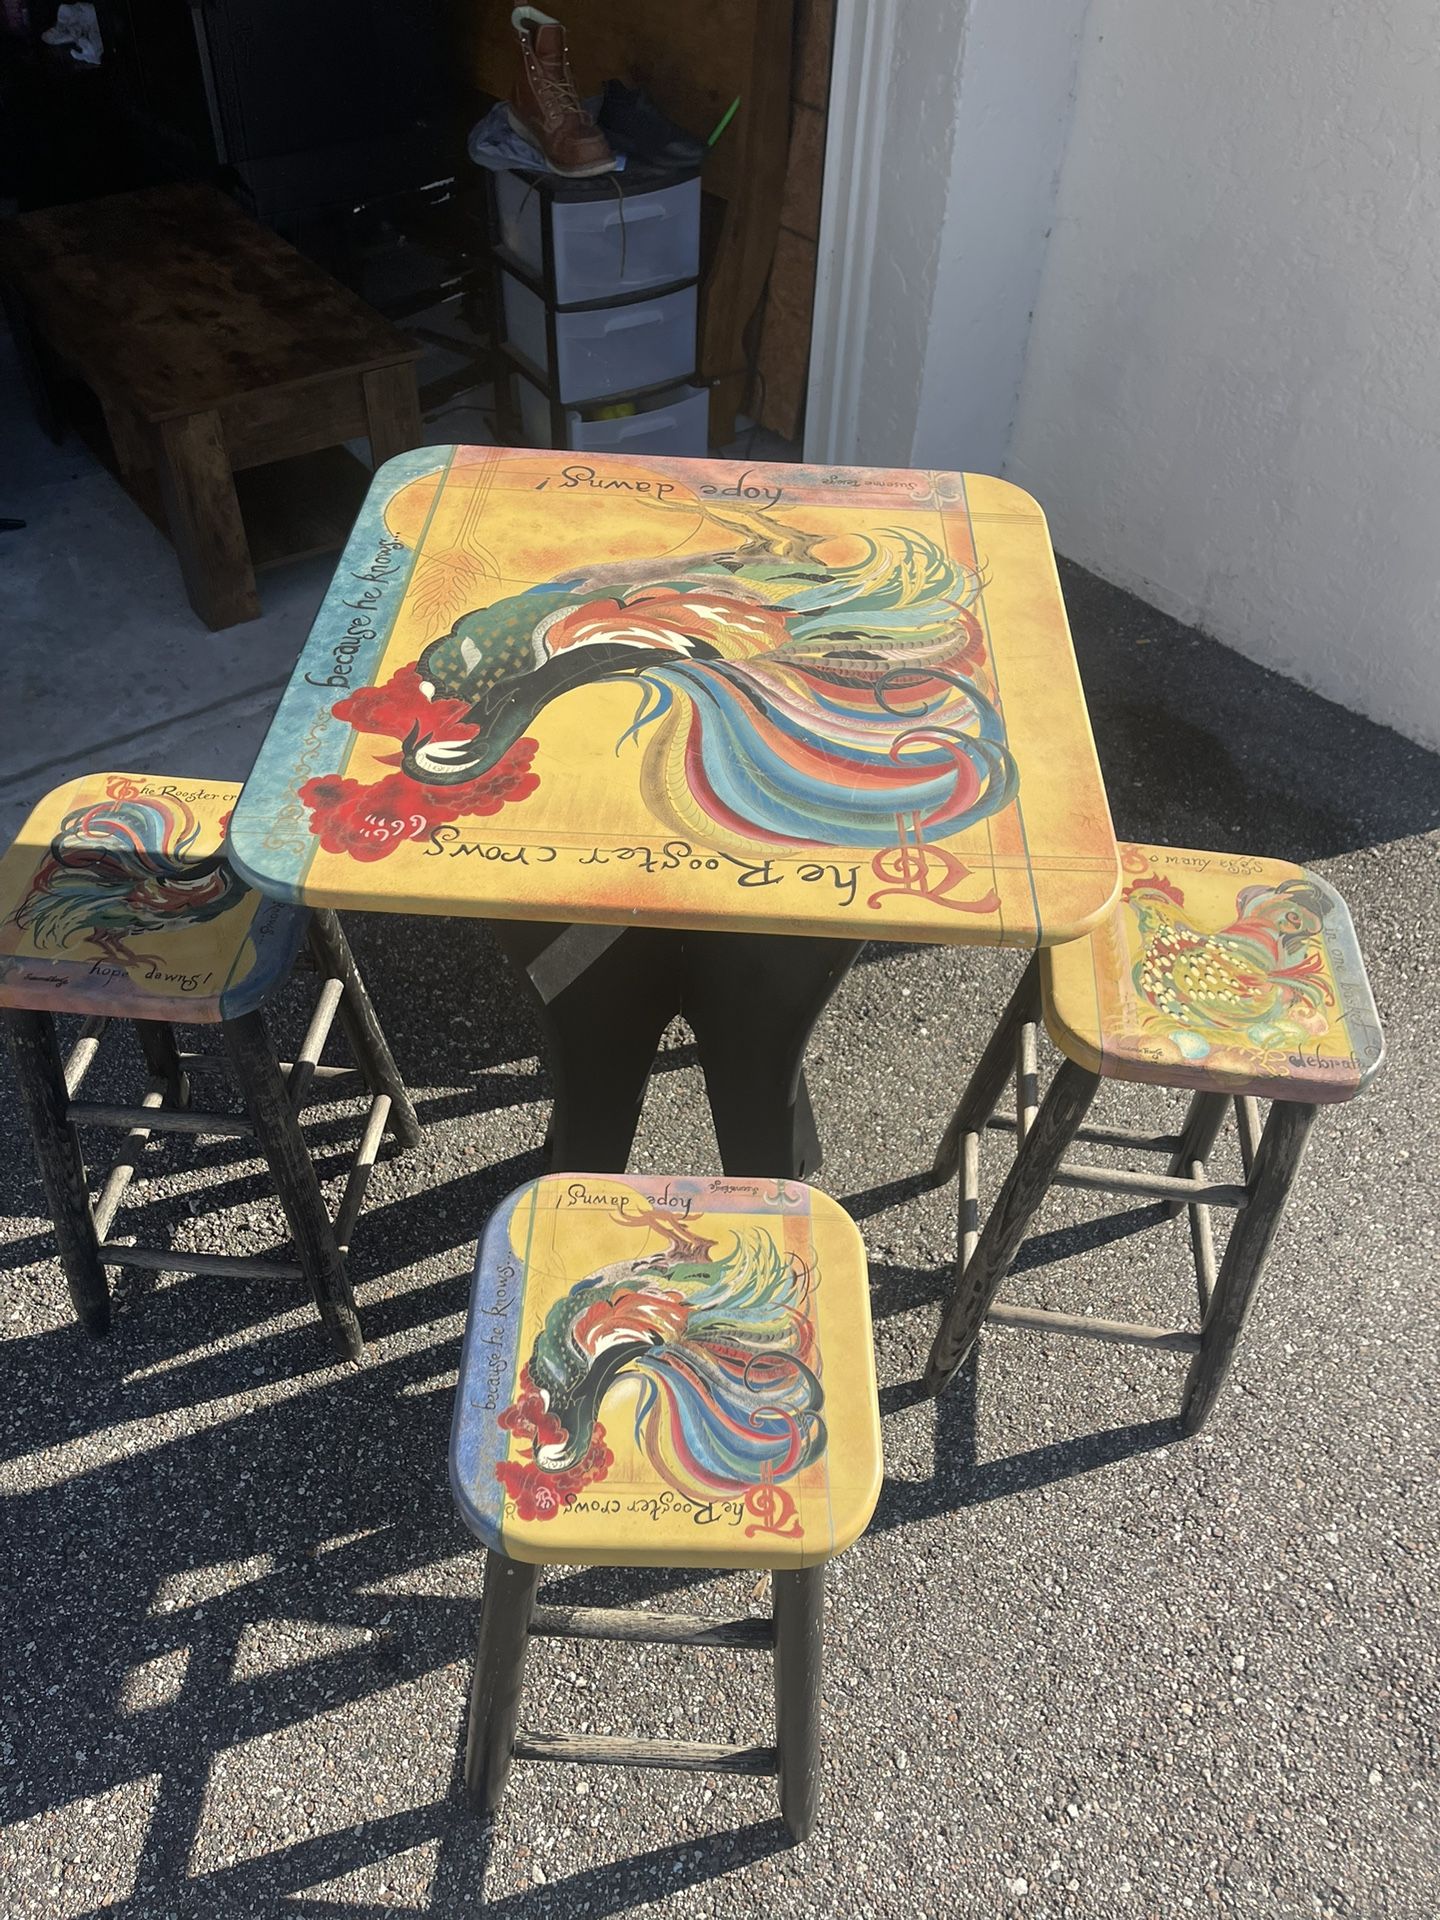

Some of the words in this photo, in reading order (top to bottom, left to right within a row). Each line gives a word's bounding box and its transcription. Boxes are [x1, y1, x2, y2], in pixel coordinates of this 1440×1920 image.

[700, 469, 784, 512] hope
[304, 615, 377, 689] because
[342, 587, 383, 610] he
[105, 775, 155, 812] The
[158, 785, 220, 803] Rooster
[423, 825, 557, 866] crows
[578, 840, 784, 887] Rooster
[797, 811, 1001, 913] The
[1165, 855, 1212, 873] many
[1220, 856, 1263, 875] eggs
[89, 958, 129, 988] hope
[1334, 949, 1347, 973] one
[646, 1182, 692, 1219] hope
[480, 1326, 505, 1347] he
[471, 1353, 508, 1410] because
[563, 1492, 621, 1516] crows
[627, 1489, 722, 1526] Rooster
[722, 1459, 805, 1539] The
